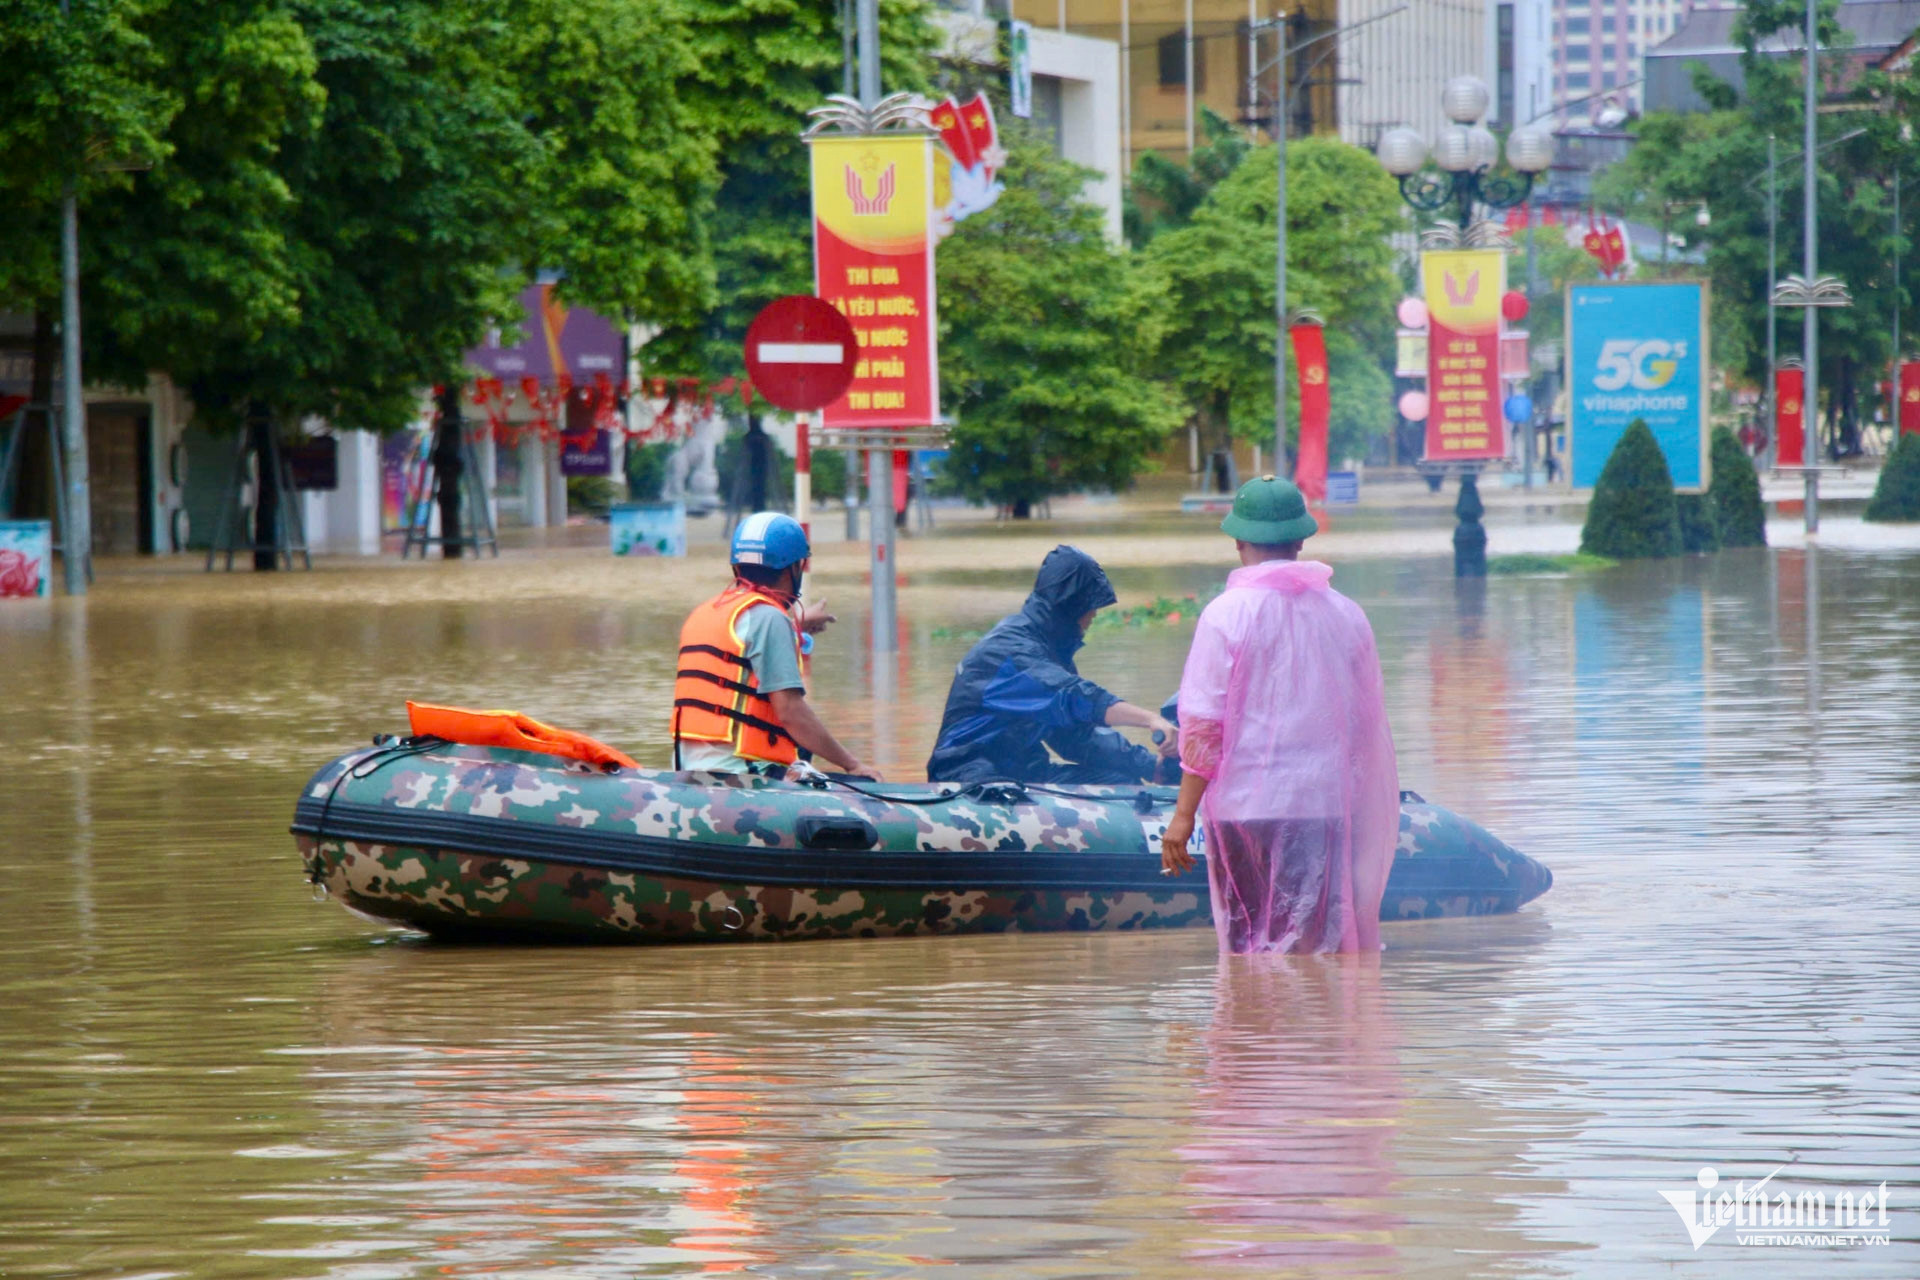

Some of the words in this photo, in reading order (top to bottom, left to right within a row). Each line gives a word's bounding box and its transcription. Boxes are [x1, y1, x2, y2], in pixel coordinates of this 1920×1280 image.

[847, 267, 869, 285] THI
[849, 391, 871, 409] THI
[1584, 394, 1688, 413] vinaphone
